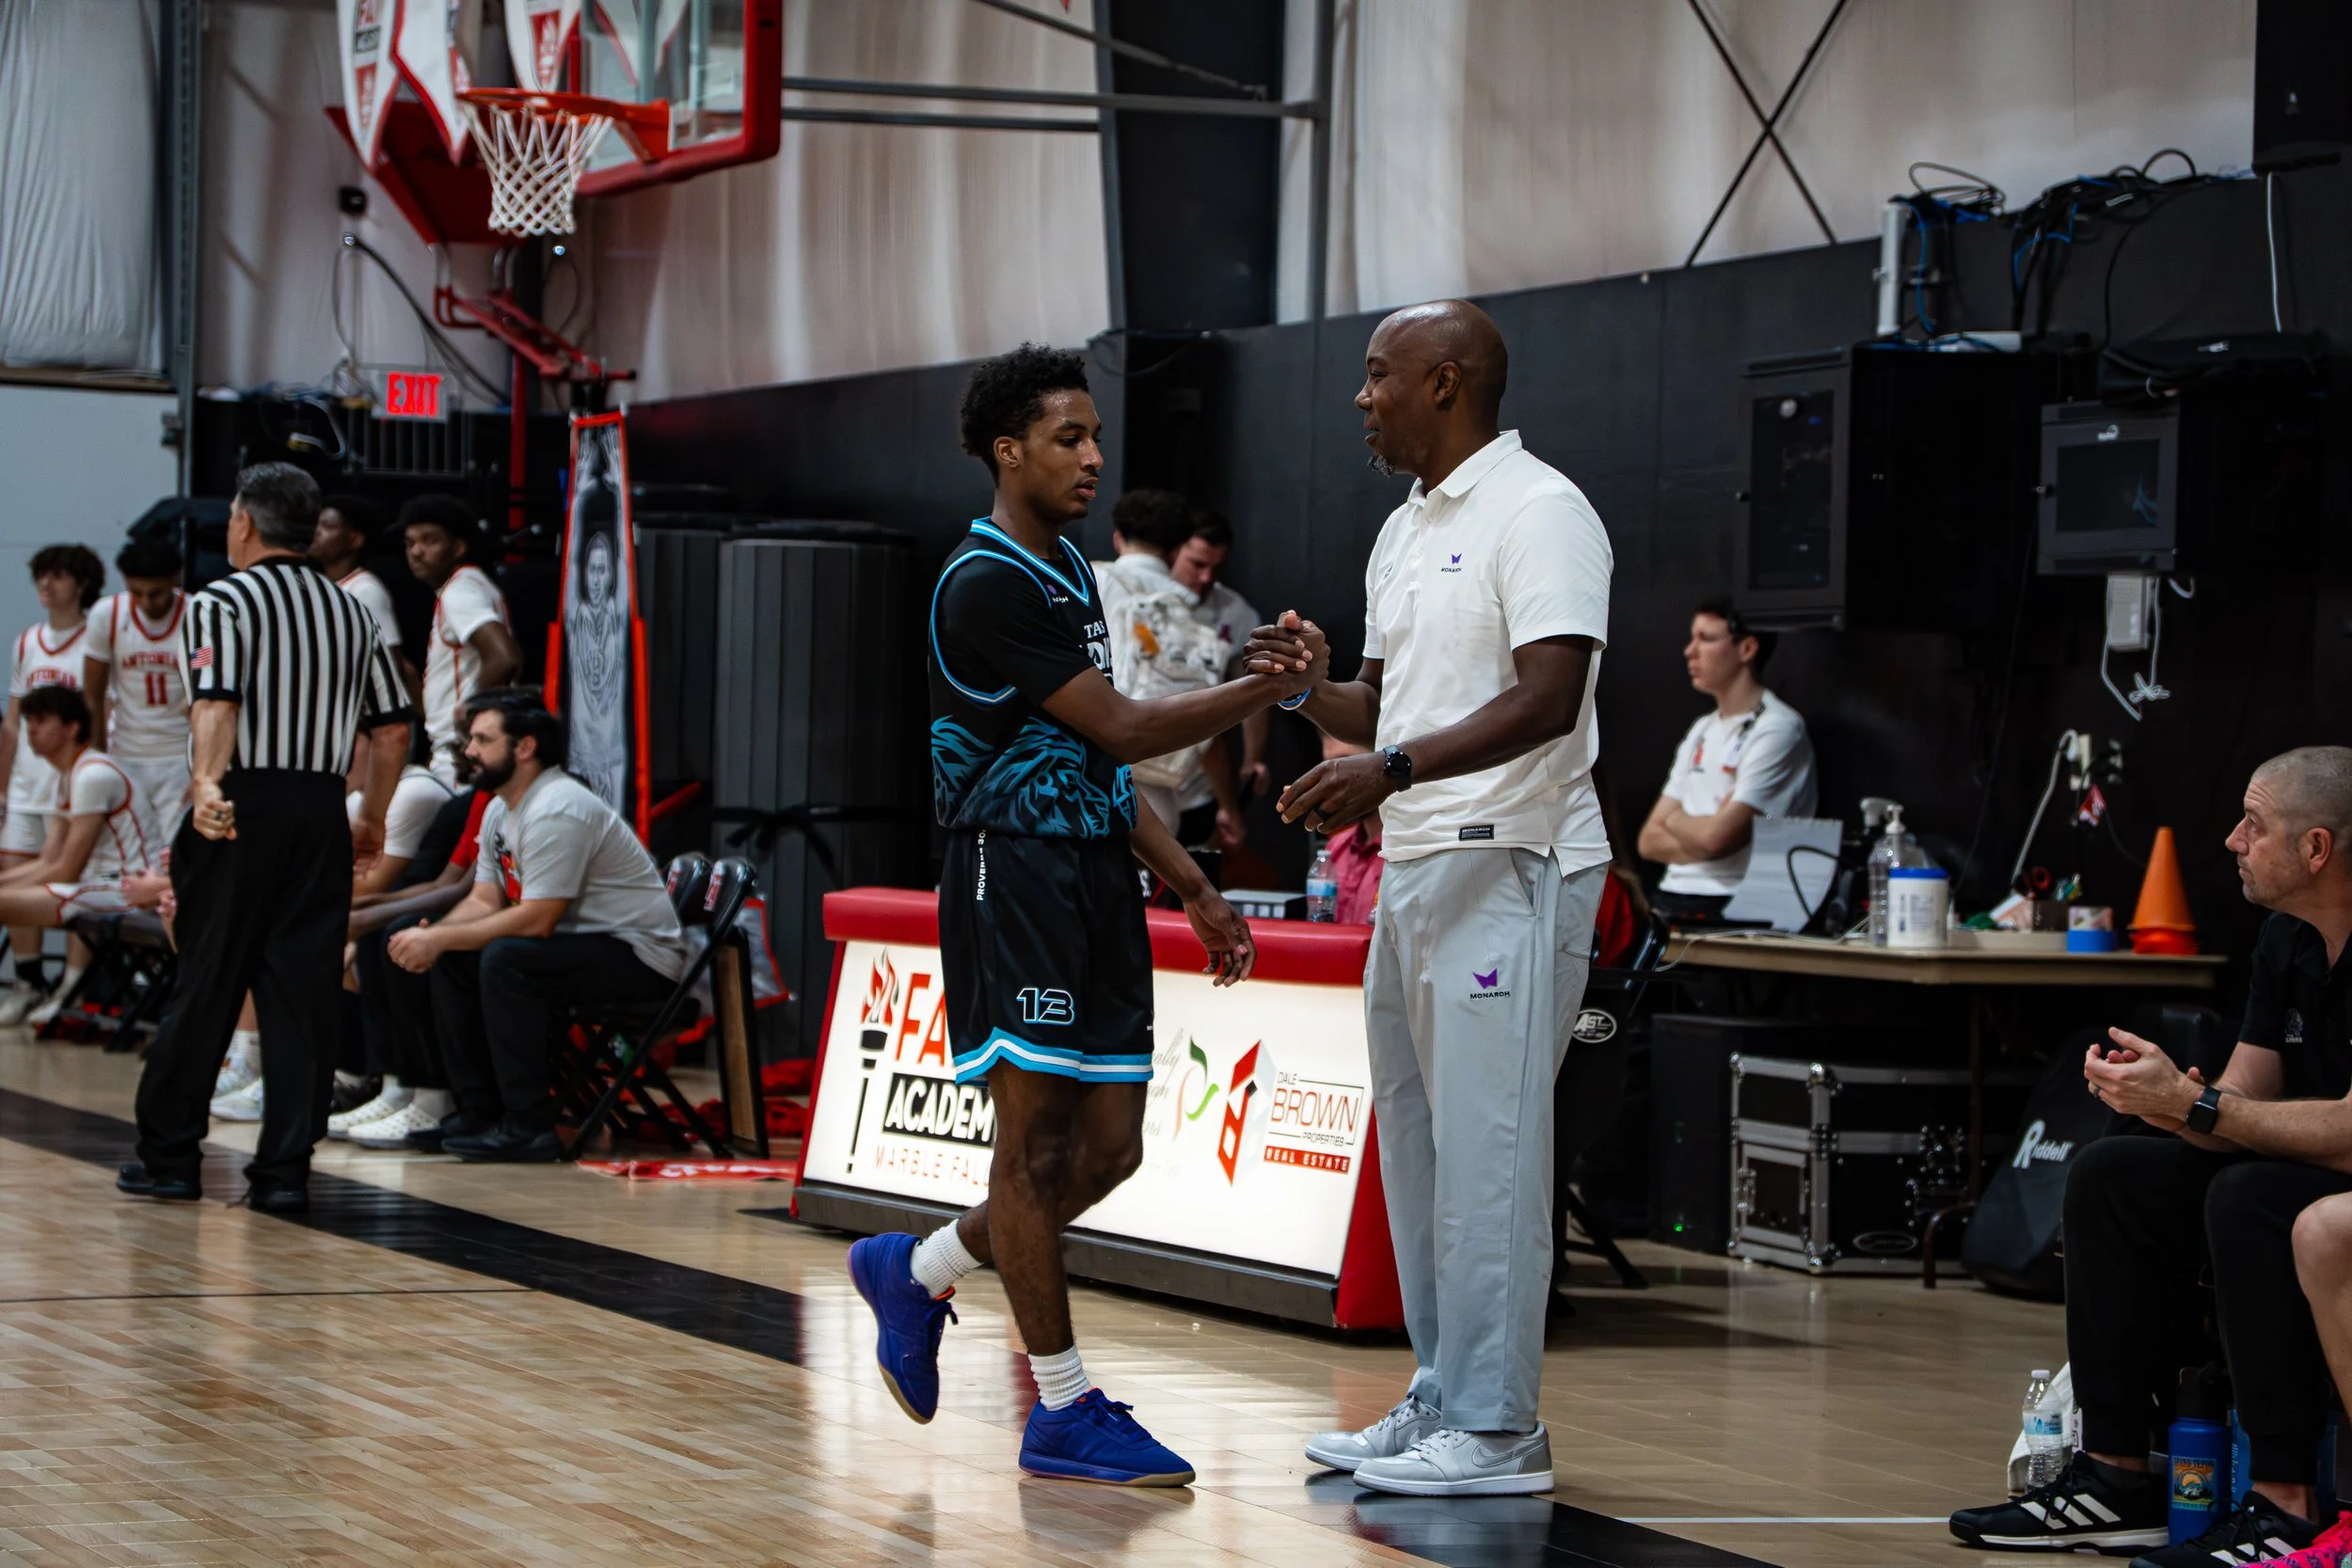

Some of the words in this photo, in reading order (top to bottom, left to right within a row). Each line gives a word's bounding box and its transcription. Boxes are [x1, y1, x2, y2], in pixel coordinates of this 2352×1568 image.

[387, 371, 441, 418] EXIT
[121, 651, 180, 671] ANTONIA
[145, 672, 168, 705] 11
[1016, 988, 1075, 1026] 13
[1470, 990, 1511, 1001] MONARCH
[895, 972, 955, 1069] FA
[1277, 1071, 1297, 1085] DALE
[883, 1078, 994, 1144] ACADEM
[1271, 1087, 1359, 1133] BROWN
[1302, 1132, 1344, 1147] PROPERTIES
[2012, 1119, 2074, 1169] Riddell
[873, 1143, 945, 1180] MARBLE
[949, 1155, 990, 1188] FALL
[1265, 1147, 1296, 1164] REAL
[1303, 1152, 1348, 1172] ESTATE
